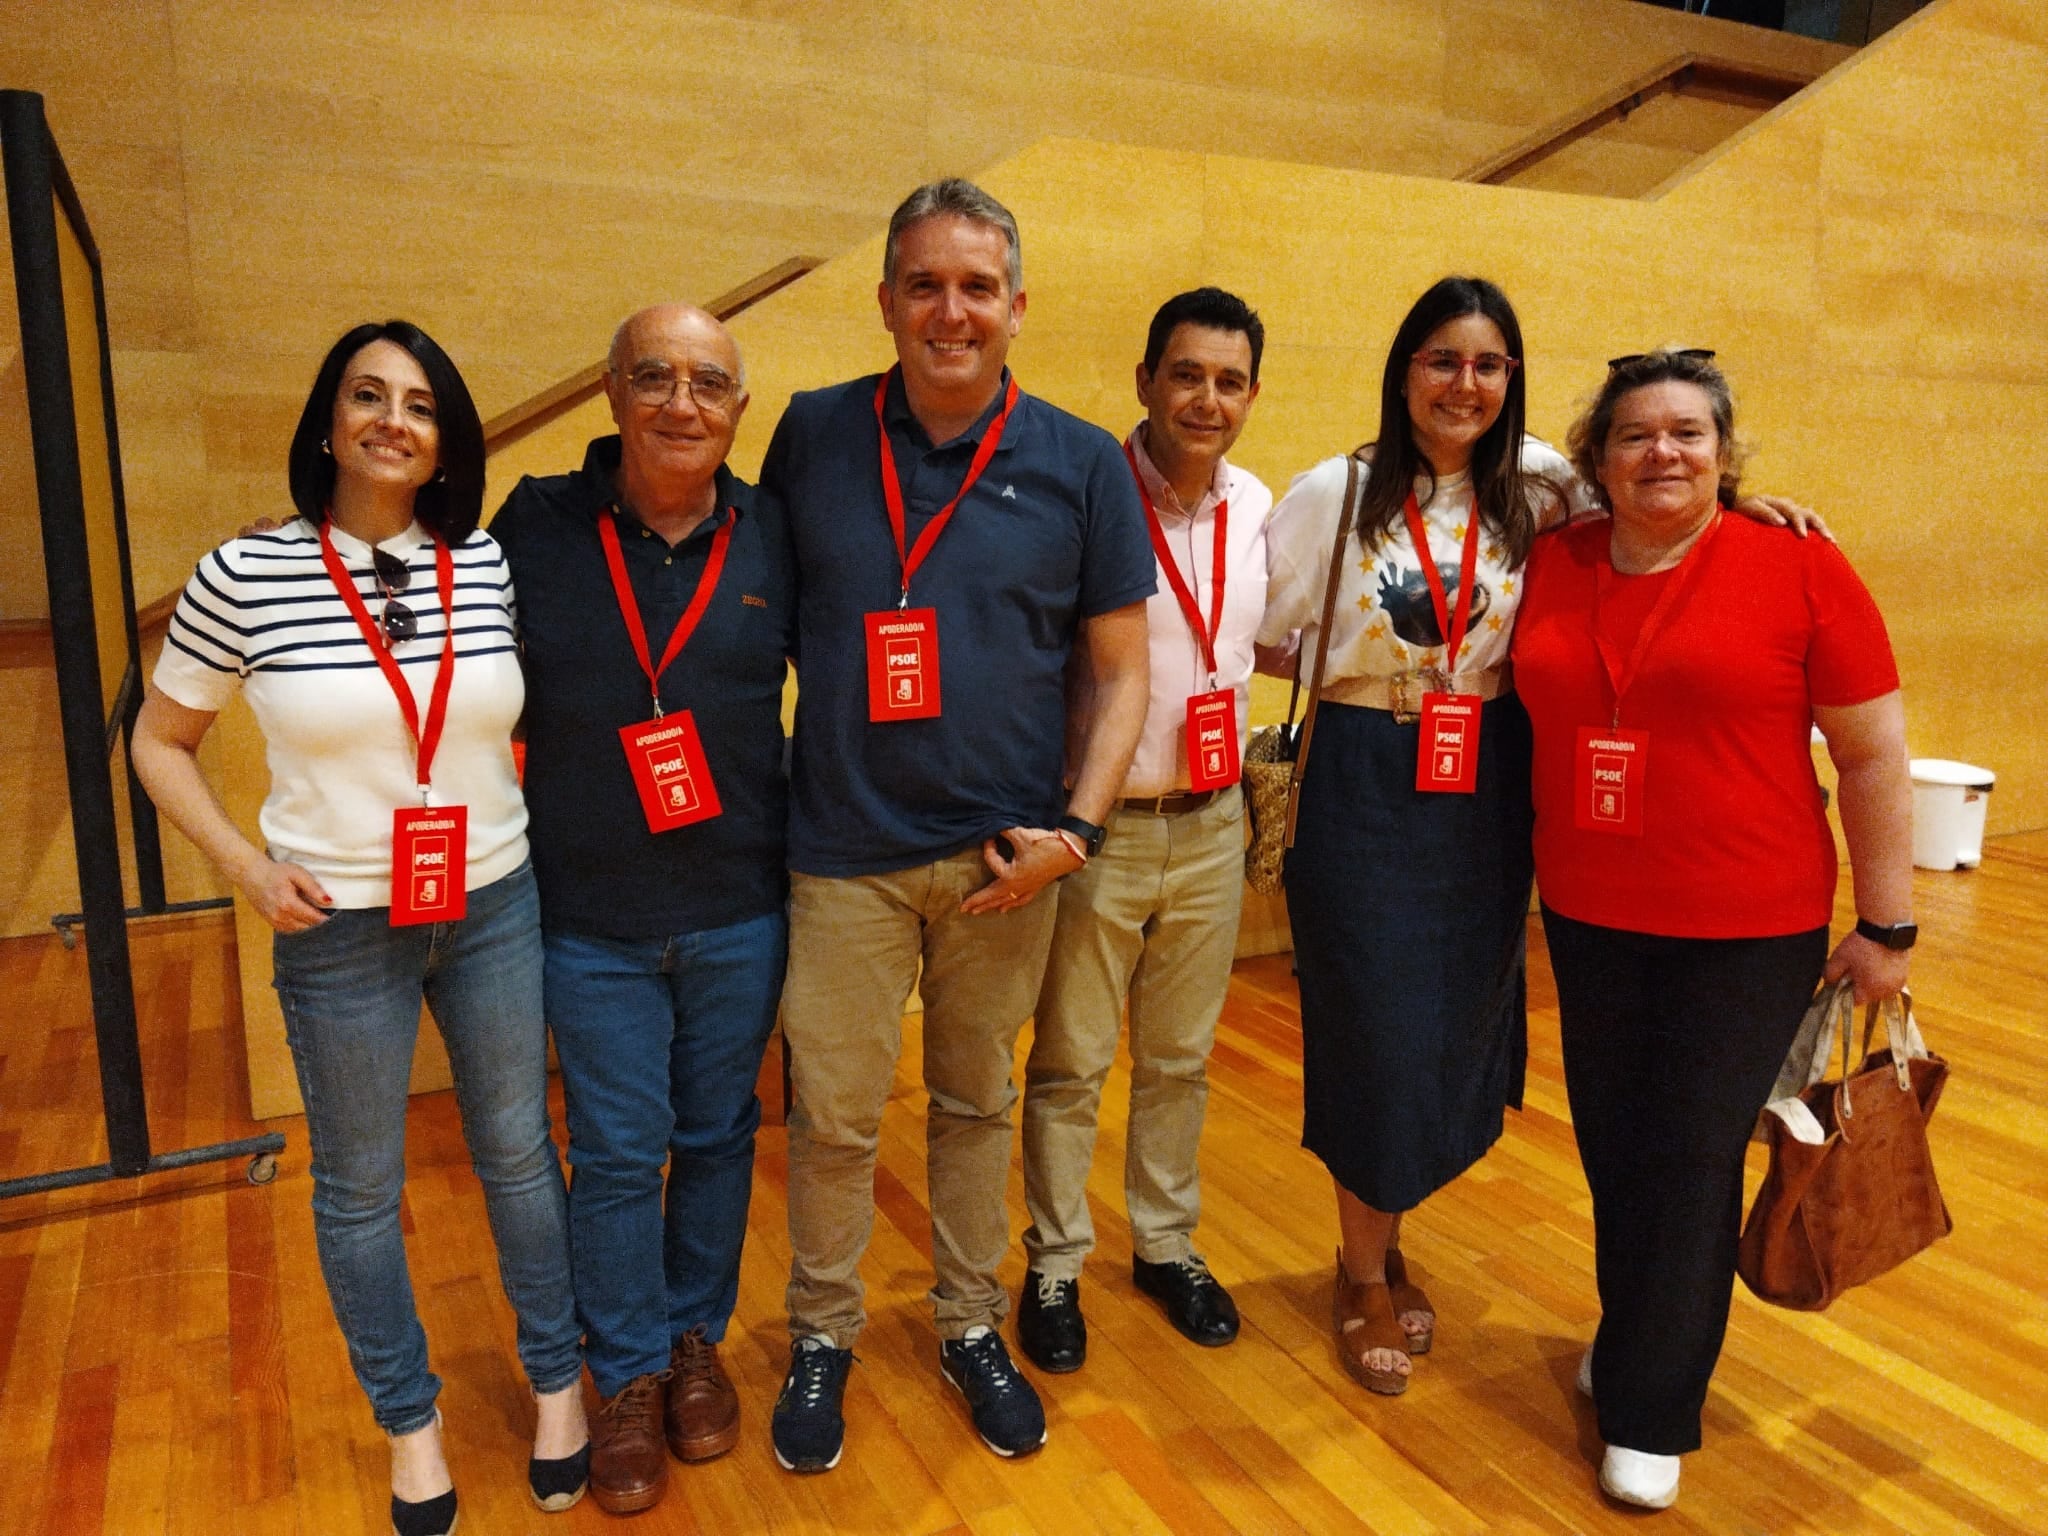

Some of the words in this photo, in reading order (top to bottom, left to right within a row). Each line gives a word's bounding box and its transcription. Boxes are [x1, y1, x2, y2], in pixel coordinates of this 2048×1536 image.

[889, 653, 918, 666] PSOE
[1201, 728, 1222, 743] PSOE
[1437, 732, 1462, 744] PSOE
[653, 758, 684, 776] PSOE
[1595, 769, 1622, 783] PSOE
[415, 852, 445, 866] PSOE
